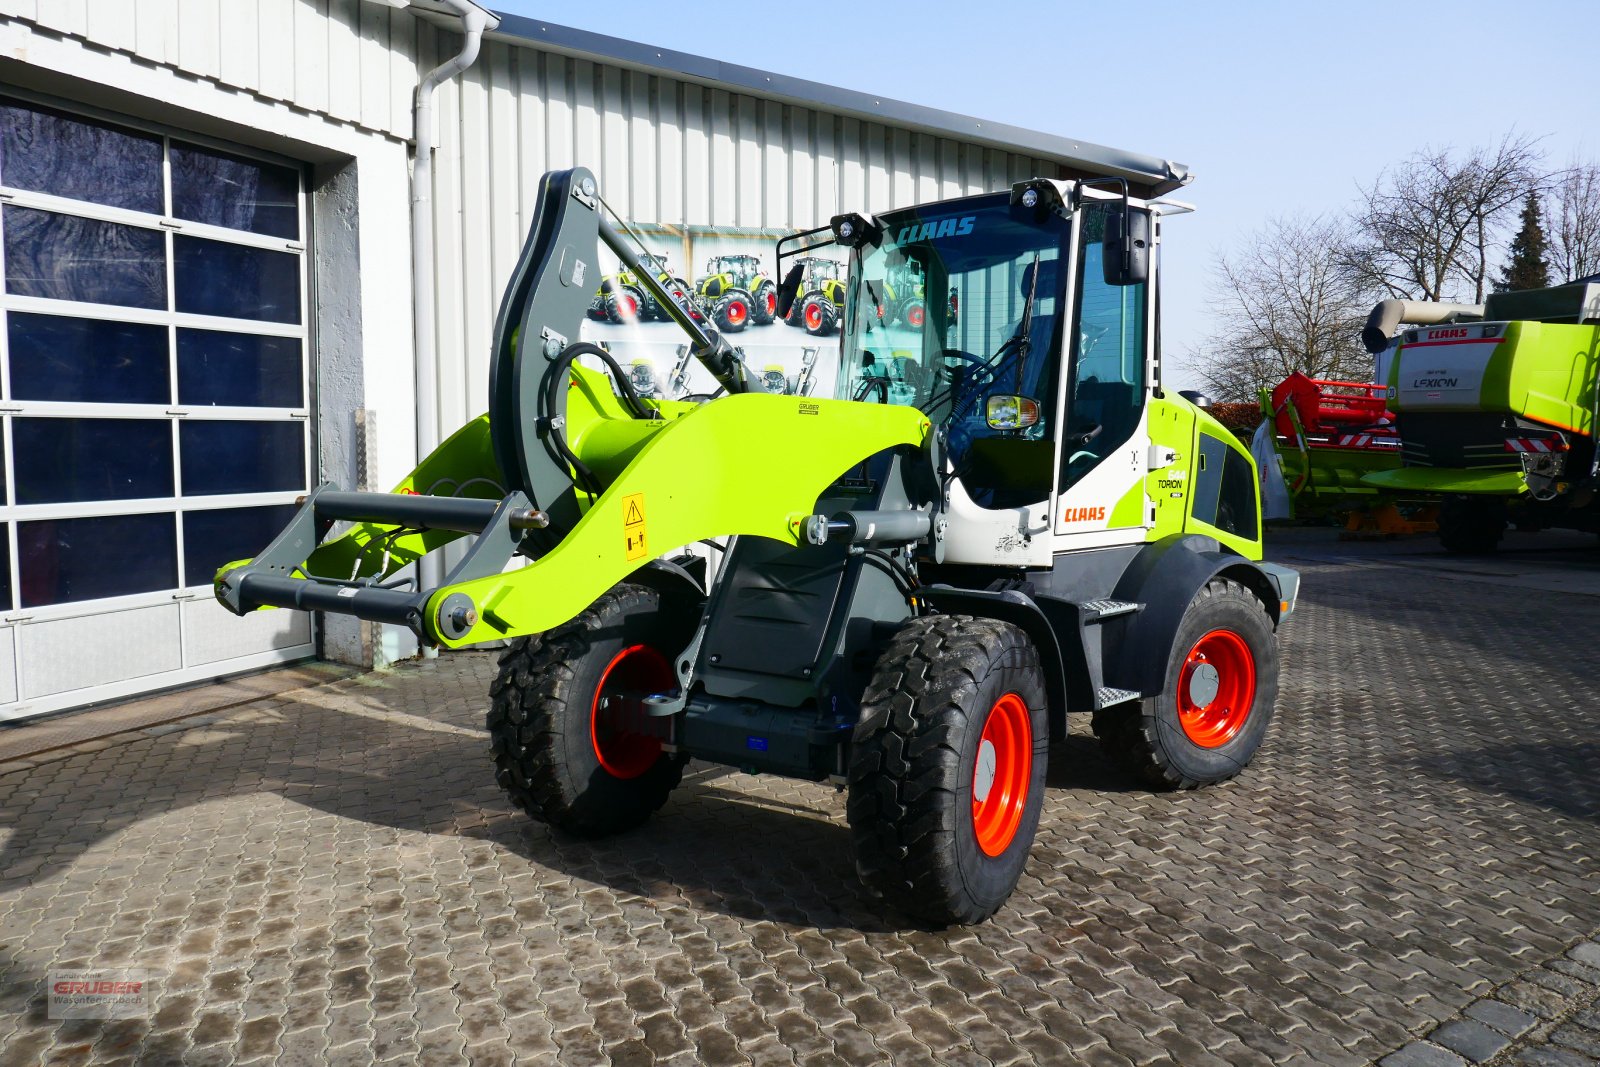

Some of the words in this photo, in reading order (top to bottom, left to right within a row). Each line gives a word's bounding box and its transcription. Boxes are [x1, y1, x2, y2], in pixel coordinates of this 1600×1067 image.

[897, 216, 976, 247] CLAAS
[1428, 328, 1467, 340] CLAAS
[1413, 378, 1458, 388] LEXION
[1158, 480, 1182, 489] TORION
[1064, 506, 1105, 522] CLAAS
